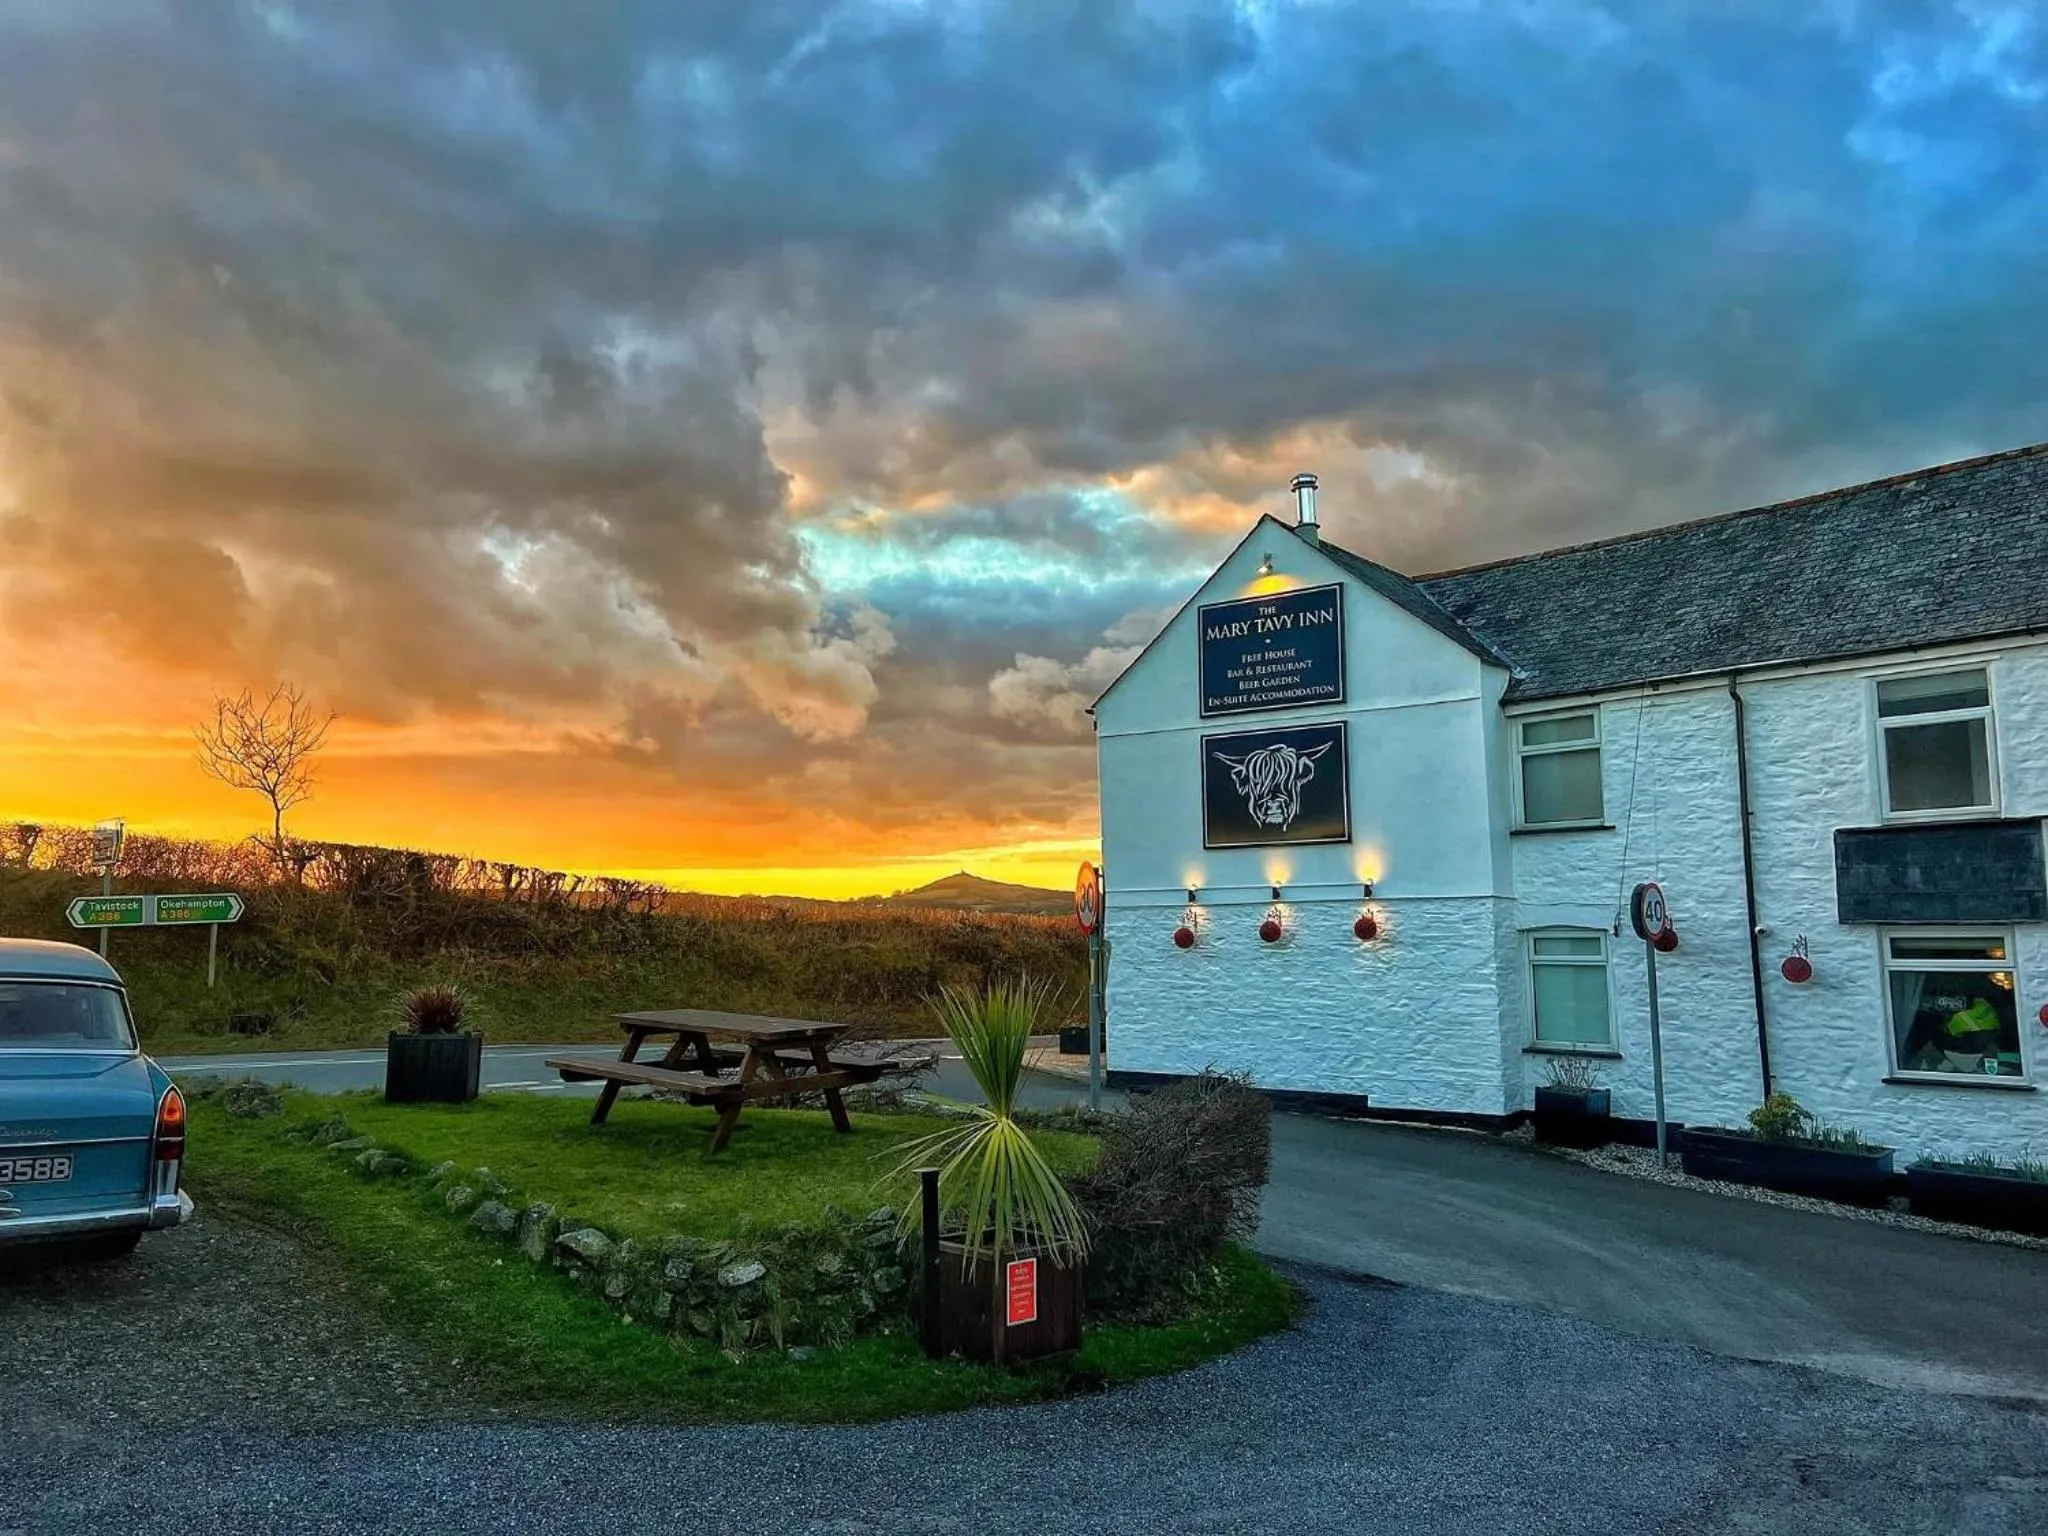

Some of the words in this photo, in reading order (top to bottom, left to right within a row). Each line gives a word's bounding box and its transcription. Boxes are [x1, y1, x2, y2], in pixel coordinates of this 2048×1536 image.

[1259, 606, 1277, 616] THE
[1207, 621, 1250, 641] MARY
[1254, 614, 1294, 633] TAVY
[1299, 607, 1333, 627] INN
[1241, 653, 1261, 664] FREE
[1265, 648, 1296, 660] HOUSE
[1227, 669, 1244, 678] BAR
[1246, 666, 1253, 676] &
[1256, 660, 1312, 674] RESTAURANT
[1239, 680, 1260, 690] BEER
[1262, 675, 1300, 688] GARDEN
[1250, 685, 1335, 701] ACCOMMODATION
[160, 899, 225, 909] Okehampton
[1080, 883, 1094, 912] 30
[88, 901, 140, 911] Tavistock
[1645, 900, 1663, 922] 40
